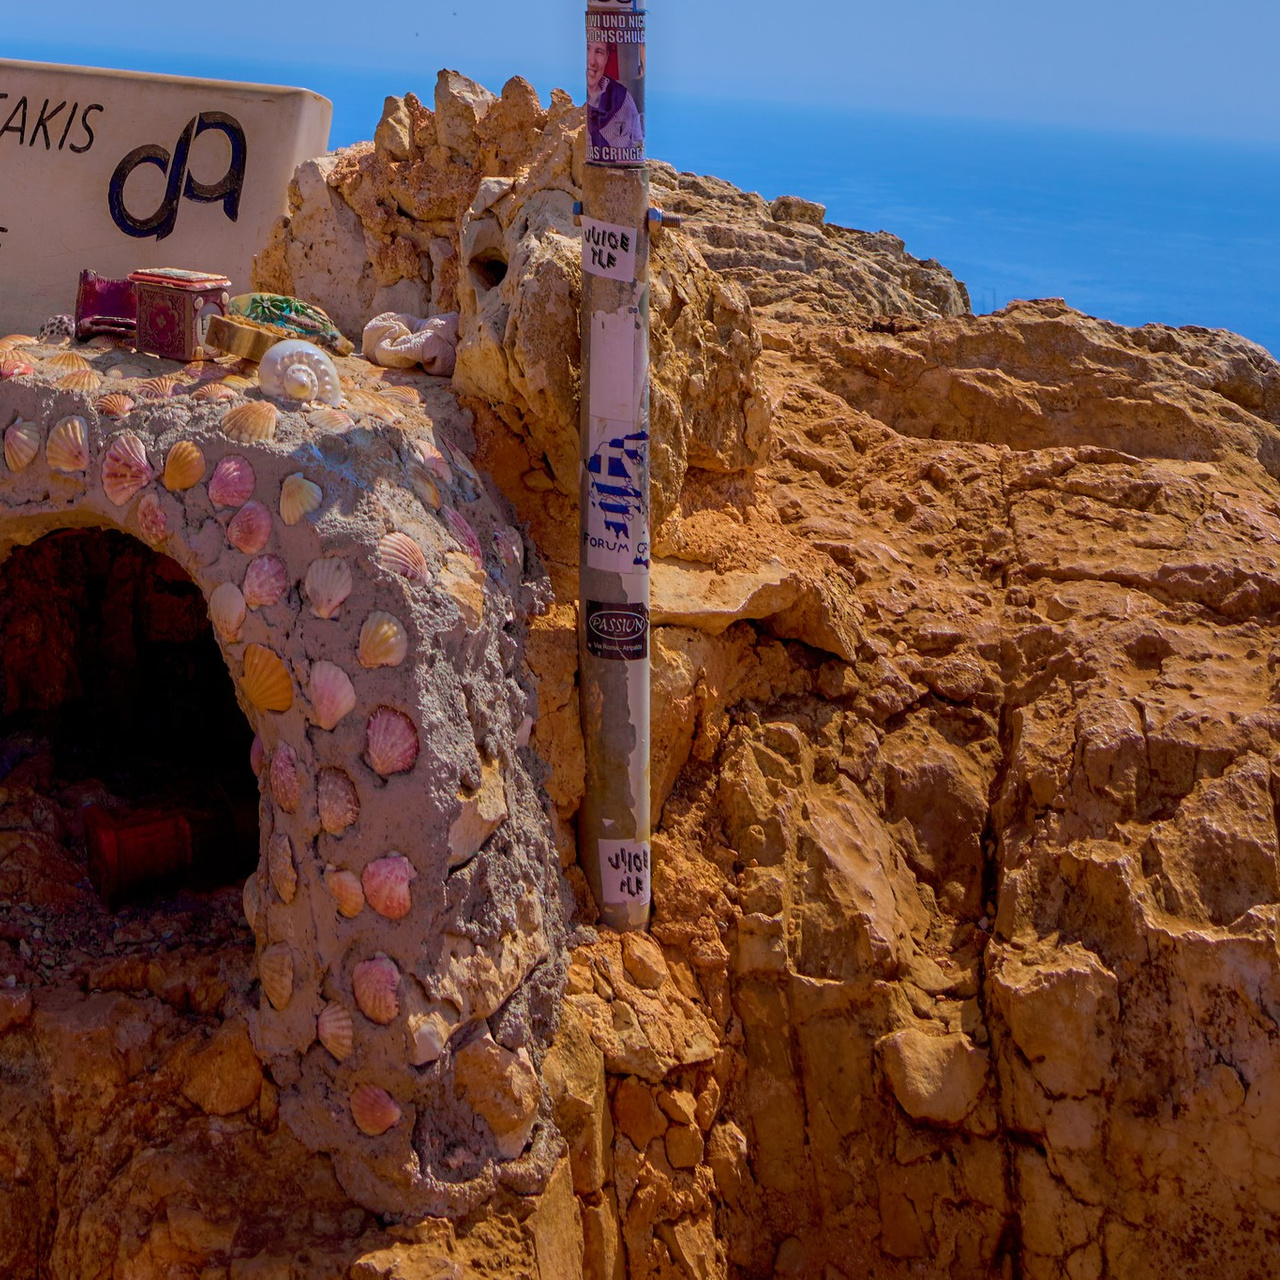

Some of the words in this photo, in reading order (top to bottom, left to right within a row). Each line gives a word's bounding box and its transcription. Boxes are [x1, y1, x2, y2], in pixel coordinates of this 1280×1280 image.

[603, 15, 625, 28] UND
[583, 532, 630, 554] FORUM
[592, 617, 644, 632] PASSION
